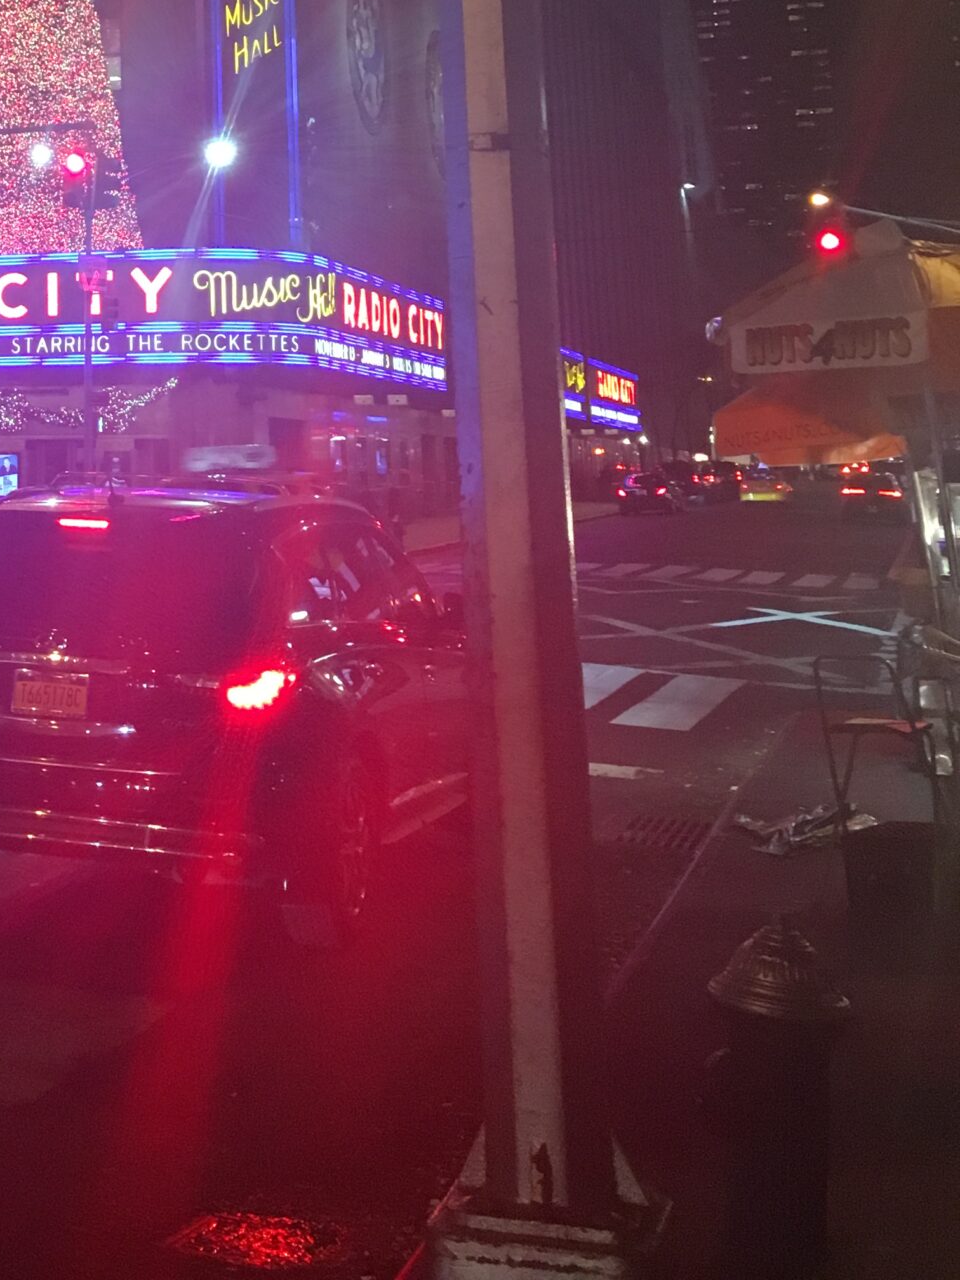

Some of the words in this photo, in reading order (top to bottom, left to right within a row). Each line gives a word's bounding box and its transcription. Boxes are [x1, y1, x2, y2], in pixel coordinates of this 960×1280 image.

[193, 269, 301, 318] Music
[342, 281, 401, 339] RADIO
[407, 304, 444, 350] CITY
[11, 335, 111, 354] STARRING
[126, 334, 164, 352] THE
[181, 334, 300, 352] ROCKETTES
